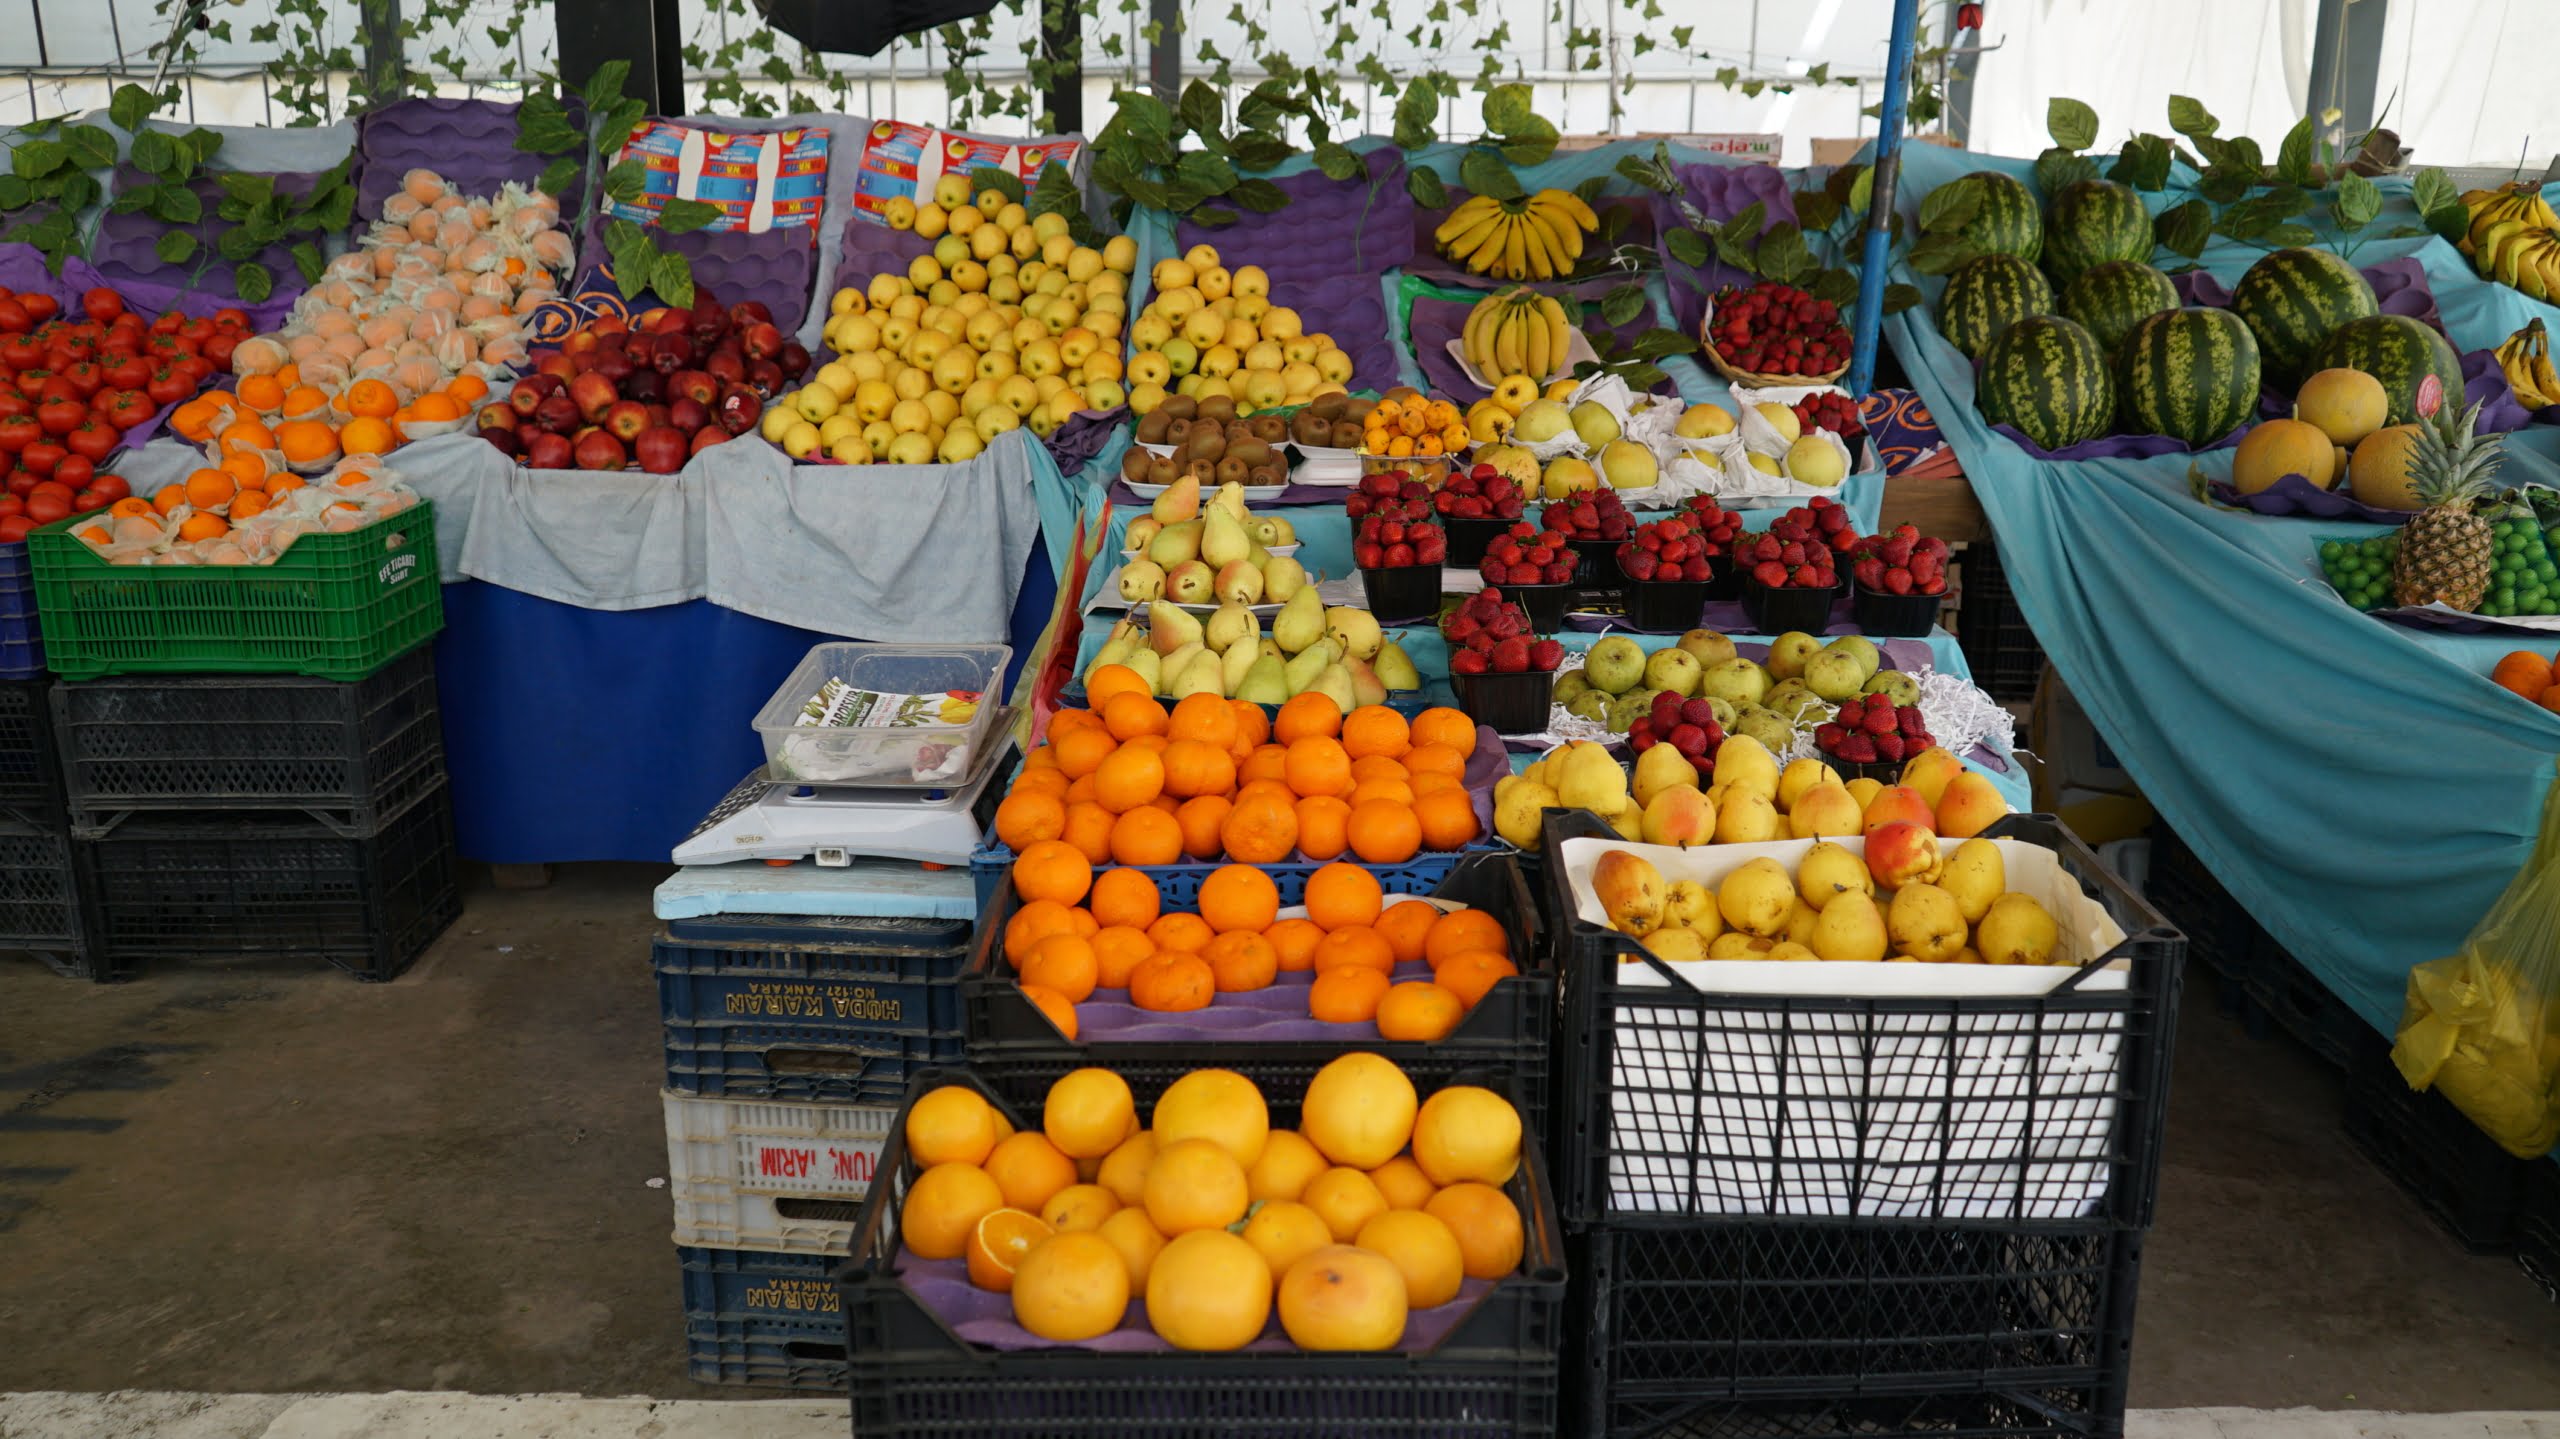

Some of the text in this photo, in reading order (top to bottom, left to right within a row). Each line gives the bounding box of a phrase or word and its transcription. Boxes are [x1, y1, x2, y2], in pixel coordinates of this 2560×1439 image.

[378, 562, 391, 583] EFE
[748, 982, 816, 996] ANKARA
[826, 985, 876, 999] NO:127
[725, 994, 824, 1017] KARAN
[768, 1279, 832, 1293] ANKARA
[746, 1287, 840, 1313] KARAN
